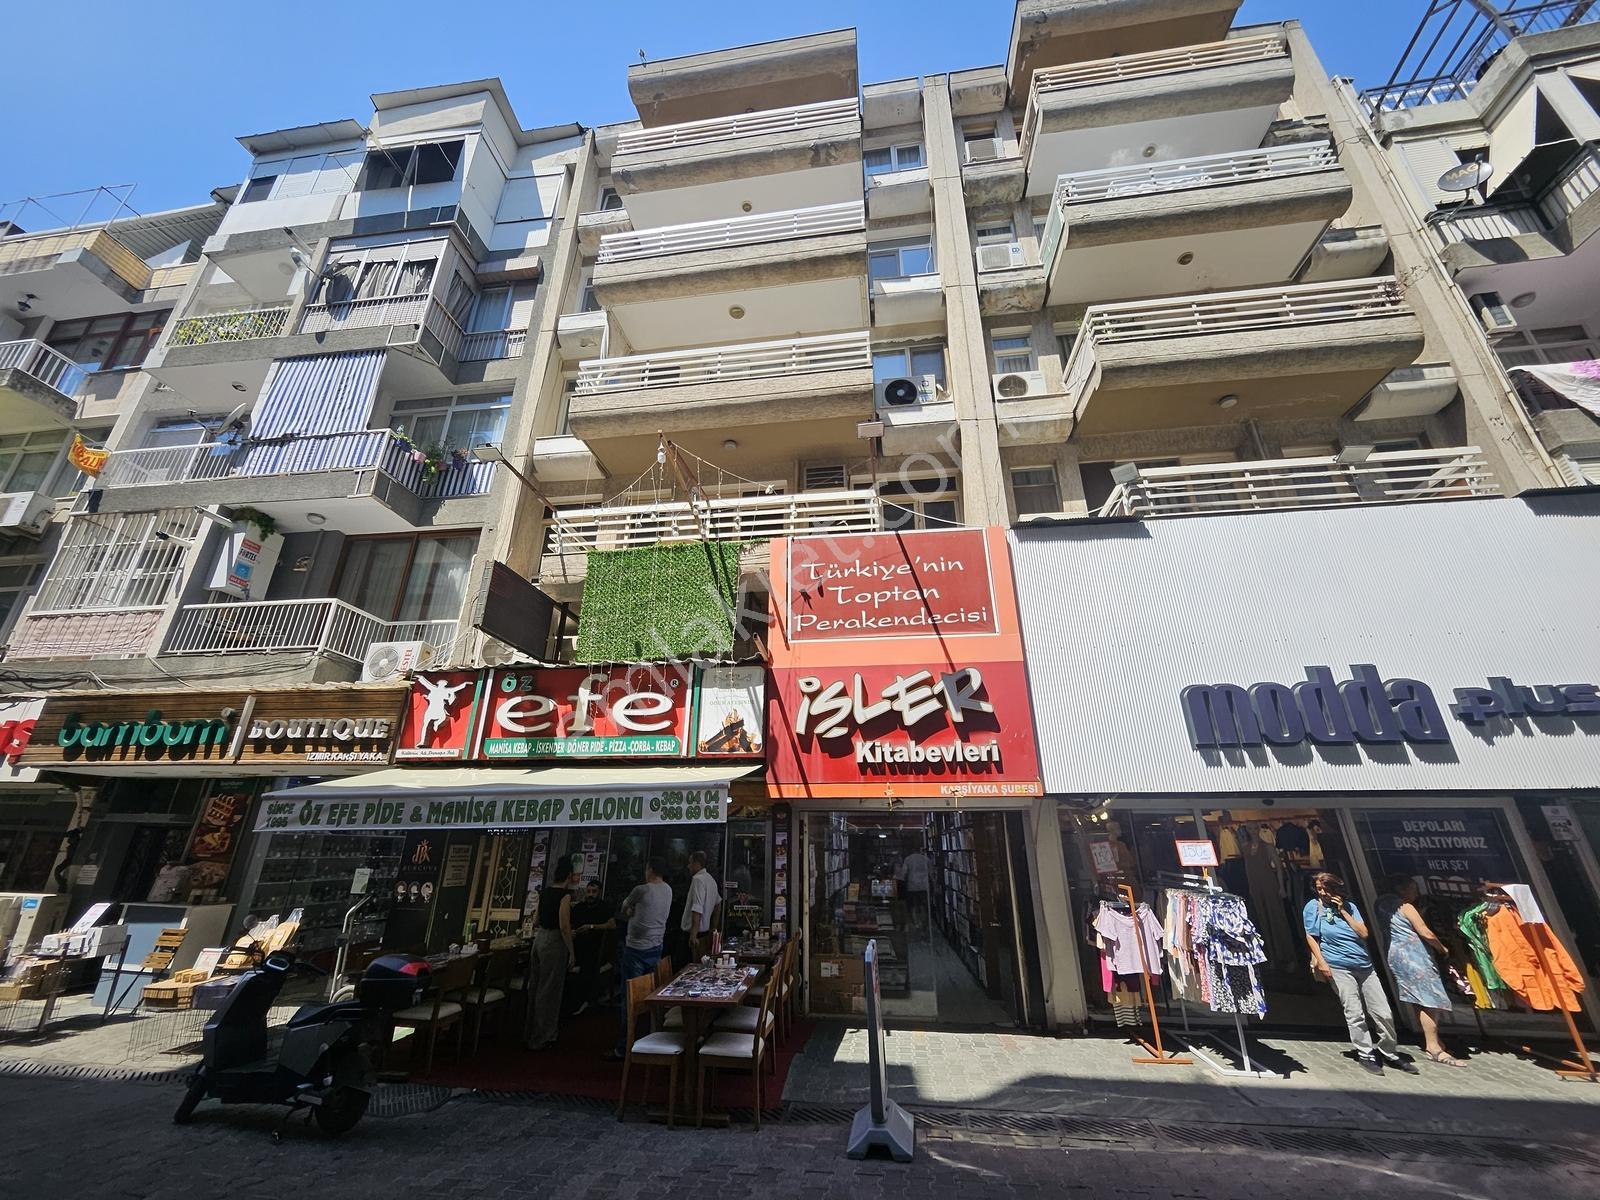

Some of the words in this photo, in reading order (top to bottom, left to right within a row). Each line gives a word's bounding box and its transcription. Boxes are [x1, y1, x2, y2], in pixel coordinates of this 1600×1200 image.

[802, 556, 964, 581] Türkiye'nin
[828, 585, 940, 609] Toptan
[794, 606, 987, 632] Perakendecisi
[497, 673, 674, 735] efe
[1180, 664, 1450, 747] modda
[1450, 676, 1600, 725] plus
[248, 718, 390, 741] BOUTIQUE
[513, 741, 532, 754] KEBAP
[567, 739, 589, 754] DÖNER
[656, 740, 676, 751] KEBAP
[856, 739, 1000, 763] Kitabevleri
[686, 791, 701, 804] 04
[704, 790, 720, 804] 04
[299, 800, 324, 825] ÖZ
[326, 803, 360, 826] EFE
[362, 800, 403, 826] PİDE
[410, 806, 423, 824] &
[426, 798, 496, 826] MANİSA
[502, 799, 562, 824] KEBAP
[569, 797, 644, 822] SALONU
[704, 805, 720, 820] 05
[1402, 820, 1465, 832] DEPOLARI
[1393, 836, 1488, 851] BOŞALTIYORUZ
[1427, 859, 1449, 870] HER
[1450, 859, 1469, 872] ŞEY
